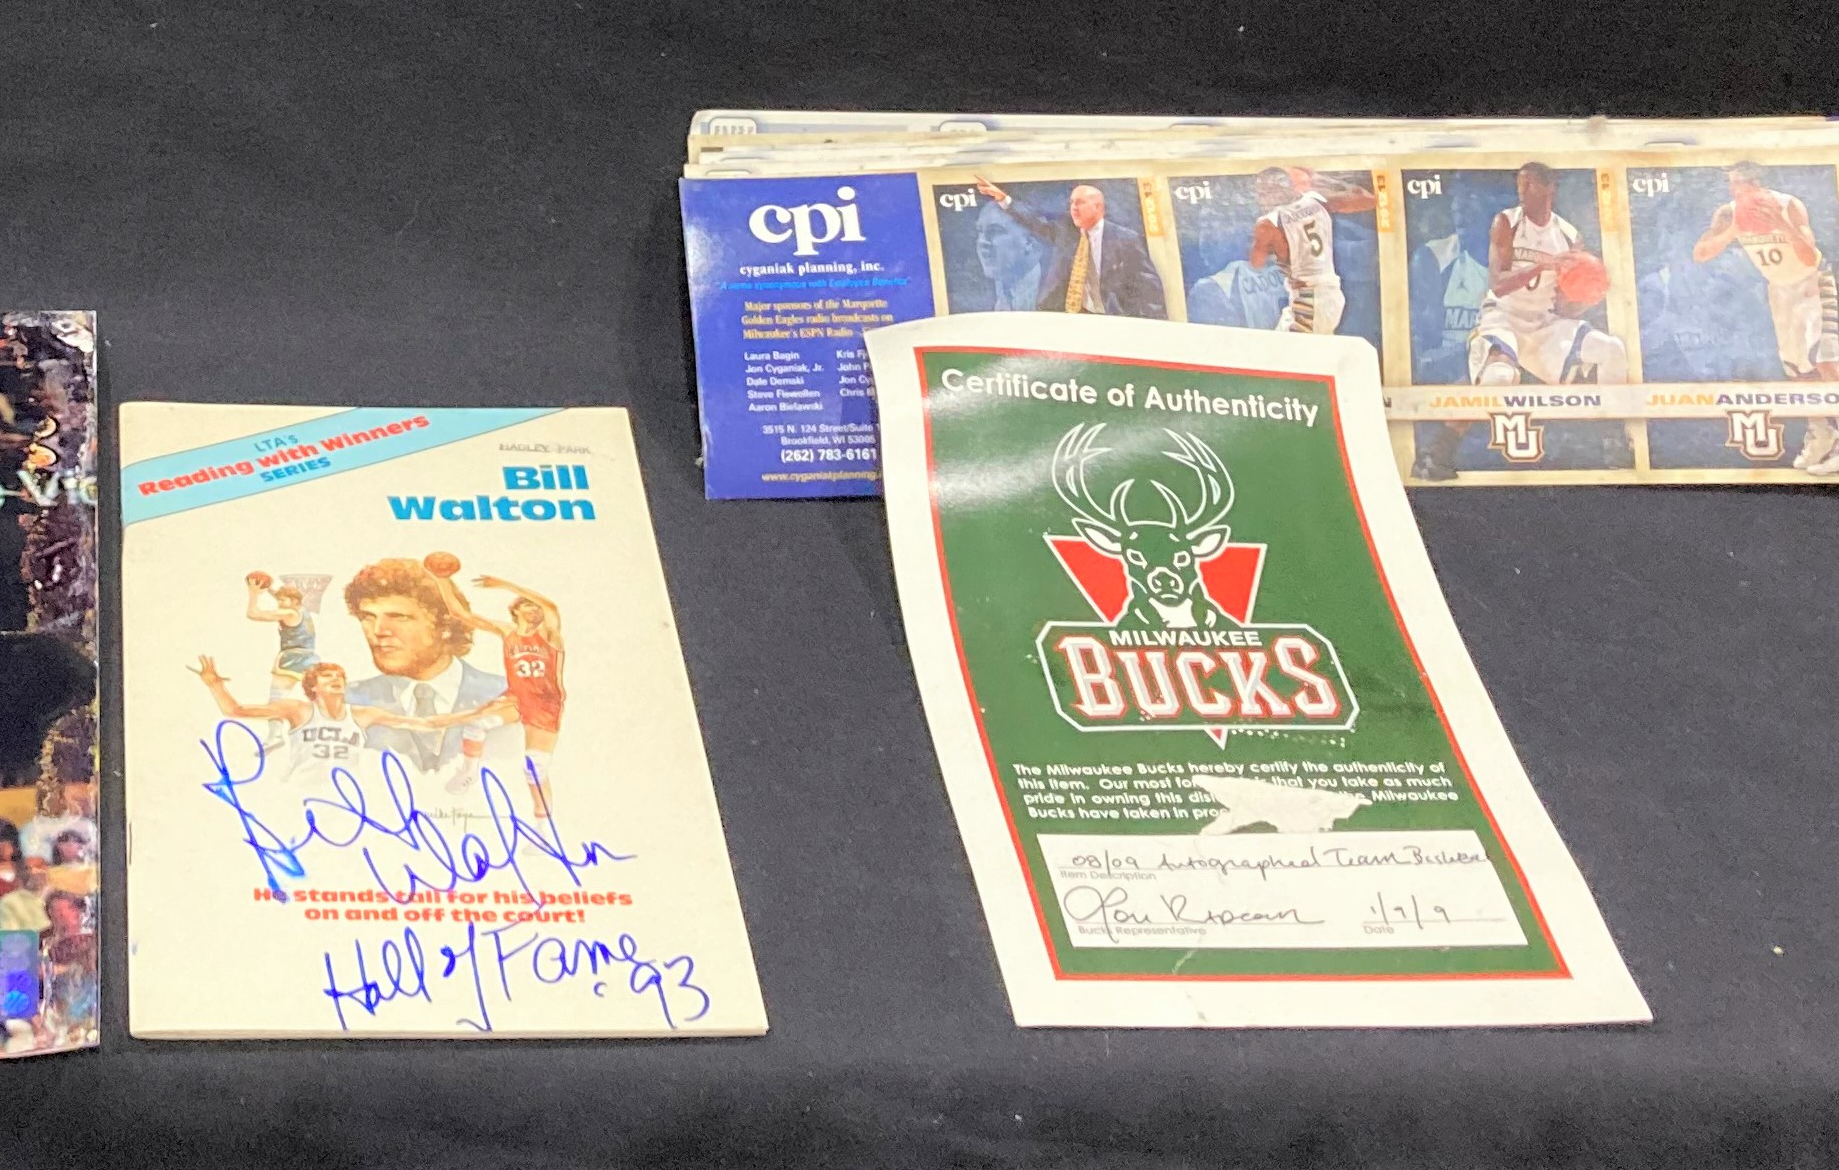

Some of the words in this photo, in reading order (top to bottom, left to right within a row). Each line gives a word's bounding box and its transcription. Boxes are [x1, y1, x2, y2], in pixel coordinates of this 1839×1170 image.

[1174, 181, 1212, 205] cpi
[1407, 174, 1442, 200] cpi
[1632, 172, 1670, 197] cpi
[939, 181, 977, 209] cpi
[749, 186, 866, 256] cpi
[1303, 222, 1324, 258] 5
[1757, 248, 1783, 267] 10
[740, 263, 794, 277] cyganiak
[798, 261, 858, 276] planning,
[861, 261, 885, 273] inc.
[744, 301, 771, 313] Major
[773, 301, 812, 313] sponsors
[813, 299, 824, 310] of
[825, 299, 840, 310] the
[842, 298, 889, 311] Marquette
[741, 314, 773, 326] Golden
[775, 314, 804, 326] Eagles
[832, 312, 880, 323] broadcasts
[799, 328, 824, 339] ESPN
[826, 327, 854, 337] Radio
[744, 351, 770, 361] Laura
[836, 349, 855, 360] Kris
[745, 364, 763, 373] Jon
[765, 363, 810, 375] Cyganiak,
[812, 362, 825, 372] Jr.
[837, 362, 862, 371] John
[838, 375, 857, 385] Jon
[747, 389, 774, 399] Steve
[839, 387, 865, 398] Chris
[941, 368, 1098, 405] Certificate
[1107, 383, 1135, 408] of
[1144, 386, 1320, 428] Authenticity
[749, 403, 777, 413] Aaron
[786, 424, 797, 434] N.
[1489, 412, 1543, 462] MU
[1726, 410, 1785, 461] MU
[781, 435, 831, 446] Brookfield,
[137, 460, 255, 497] Reading
[256, 443, 319, 470] with
[320, 414, 431, 453] Winners
[780, 448, 814, 463] (262)
[817, 448, 877, 461] 783-6161
[259, 456, 332, 483] SERIES
[501, 464, 590, 491] Bill
[387, 494, 596, 522] Walton
[1110, 630, 1263, 647] MILWAUKEE
[514, 659, 546, 679] 32
[1055, 634, 1343, 719] BUCKS
[312, 743, 349, 761] 32
[1012, 763, 1042, 776] The
[1046, 763, 1133, 776] Milwaukee
[1136, 762, 1184, 775] Bucks
[1188, 761, 1244, 775] hereby
[1250, 761, 1298, 776] certify
[1302, 760, 1329, 773] the
[1332, 761, 1424, 775] authenticity
[1429, 761, 1446, 773] of
[1017, 777, 1046, 790] this
[1048, 777, 1090, 791] item.
[1098, 778, 1129, 790] Our
[1133, 776, 1172, 790] most
[1271, 775, 1304, 788] that
[1309, 776, 1338, 790] you
[1341, 775, 1379, 788] take
[1383, 777, 1402, 788] as
[1406, 775, 1454, 788] much
[1023, 792, 1066, 807] pride
[1070, 792, 1086, 805] in
[1091, 793, 1152, 808] owning
[1154, 790, 1184, 804] this
[1370, 789, 1460, 802] Milwaukee
[1027, 806, 1075, 820] Bucks
[1078, 806, 1120, 820] have
[1122, 806, 1171, 820] taken
[1173, 806, 1189, 819] in
[1323, 847, 1412, 866] Team
[1060, 871, 1087, 879] Item
[1089, 871, 1157, 881] Description
[293, 888, 389, 904] stands
[395, 888, 442, 904] tall
[447, 889, 490, 904] for
[493, 889, 534, 905] his
[540, 889, 633, 906] beliefs
[304, 908, 340, 921] on
[345, 907, 400, 922] and
[404, 907, 446, 922] off
[450, 907, 490, 922] the
[493, 908, 586, 923] court!
[1116, 926, 1207, 936] Representative
[1363, 925, 1395, 935] Date
[323, 926, 432, 1030] Hall
[487, 928, 644, 1000] Fame
